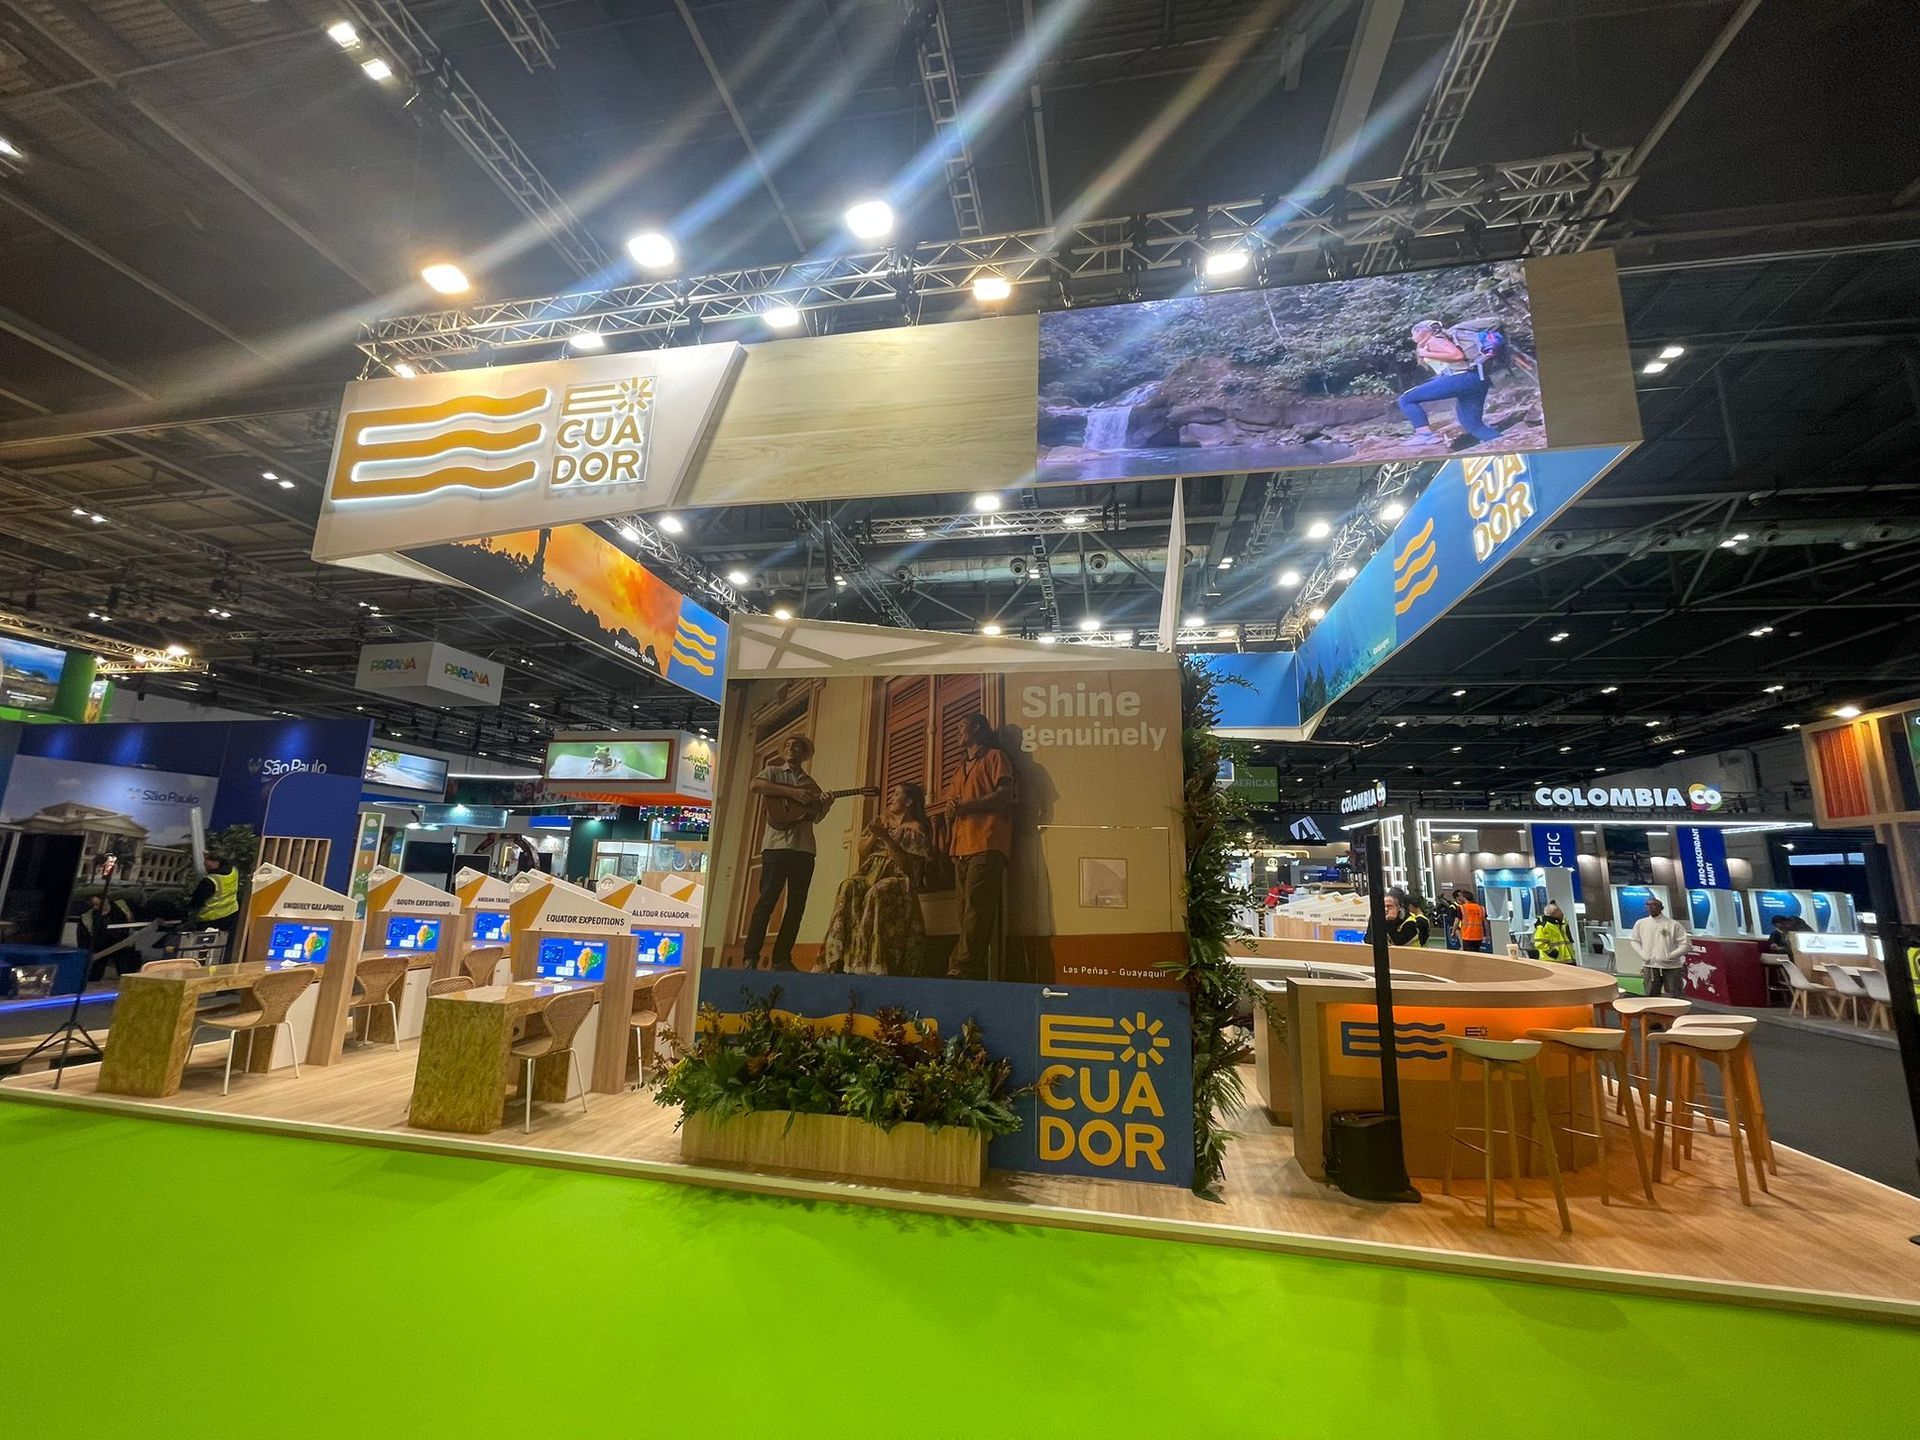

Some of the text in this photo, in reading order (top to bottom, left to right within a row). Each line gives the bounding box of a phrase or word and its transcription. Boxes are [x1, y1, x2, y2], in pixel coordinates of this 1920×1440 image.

[1022, 682, 1141, 718] Shine
[1021, 721, 1167, 753] genuinely
[262, 759, 290, 775] São
[142, 789, 200, 805] São Paulo
[1341, 788, 1377, 814] COLOMBIA
[1535, 787, 1687, 807] COLOMBIA
[1547, 832, 1563, 868] CIFIC
[1691, 828, 1708, 886] AFRO-DESCENDANT
[1705, 862, 1717, 886] BEAUTY
[311, 903, 344, 912] GALAPAGOS
[631, 909, 690, 919] ALLTOUR ECUADOR
[546, 914, 625, 926] EQUATOR EXPEDITIONS
[1063, 965, 1078, 974] Las
[1081, 966, 1109, 975] Peñas
[1119, 968, 1167, 978] Guayaquil
